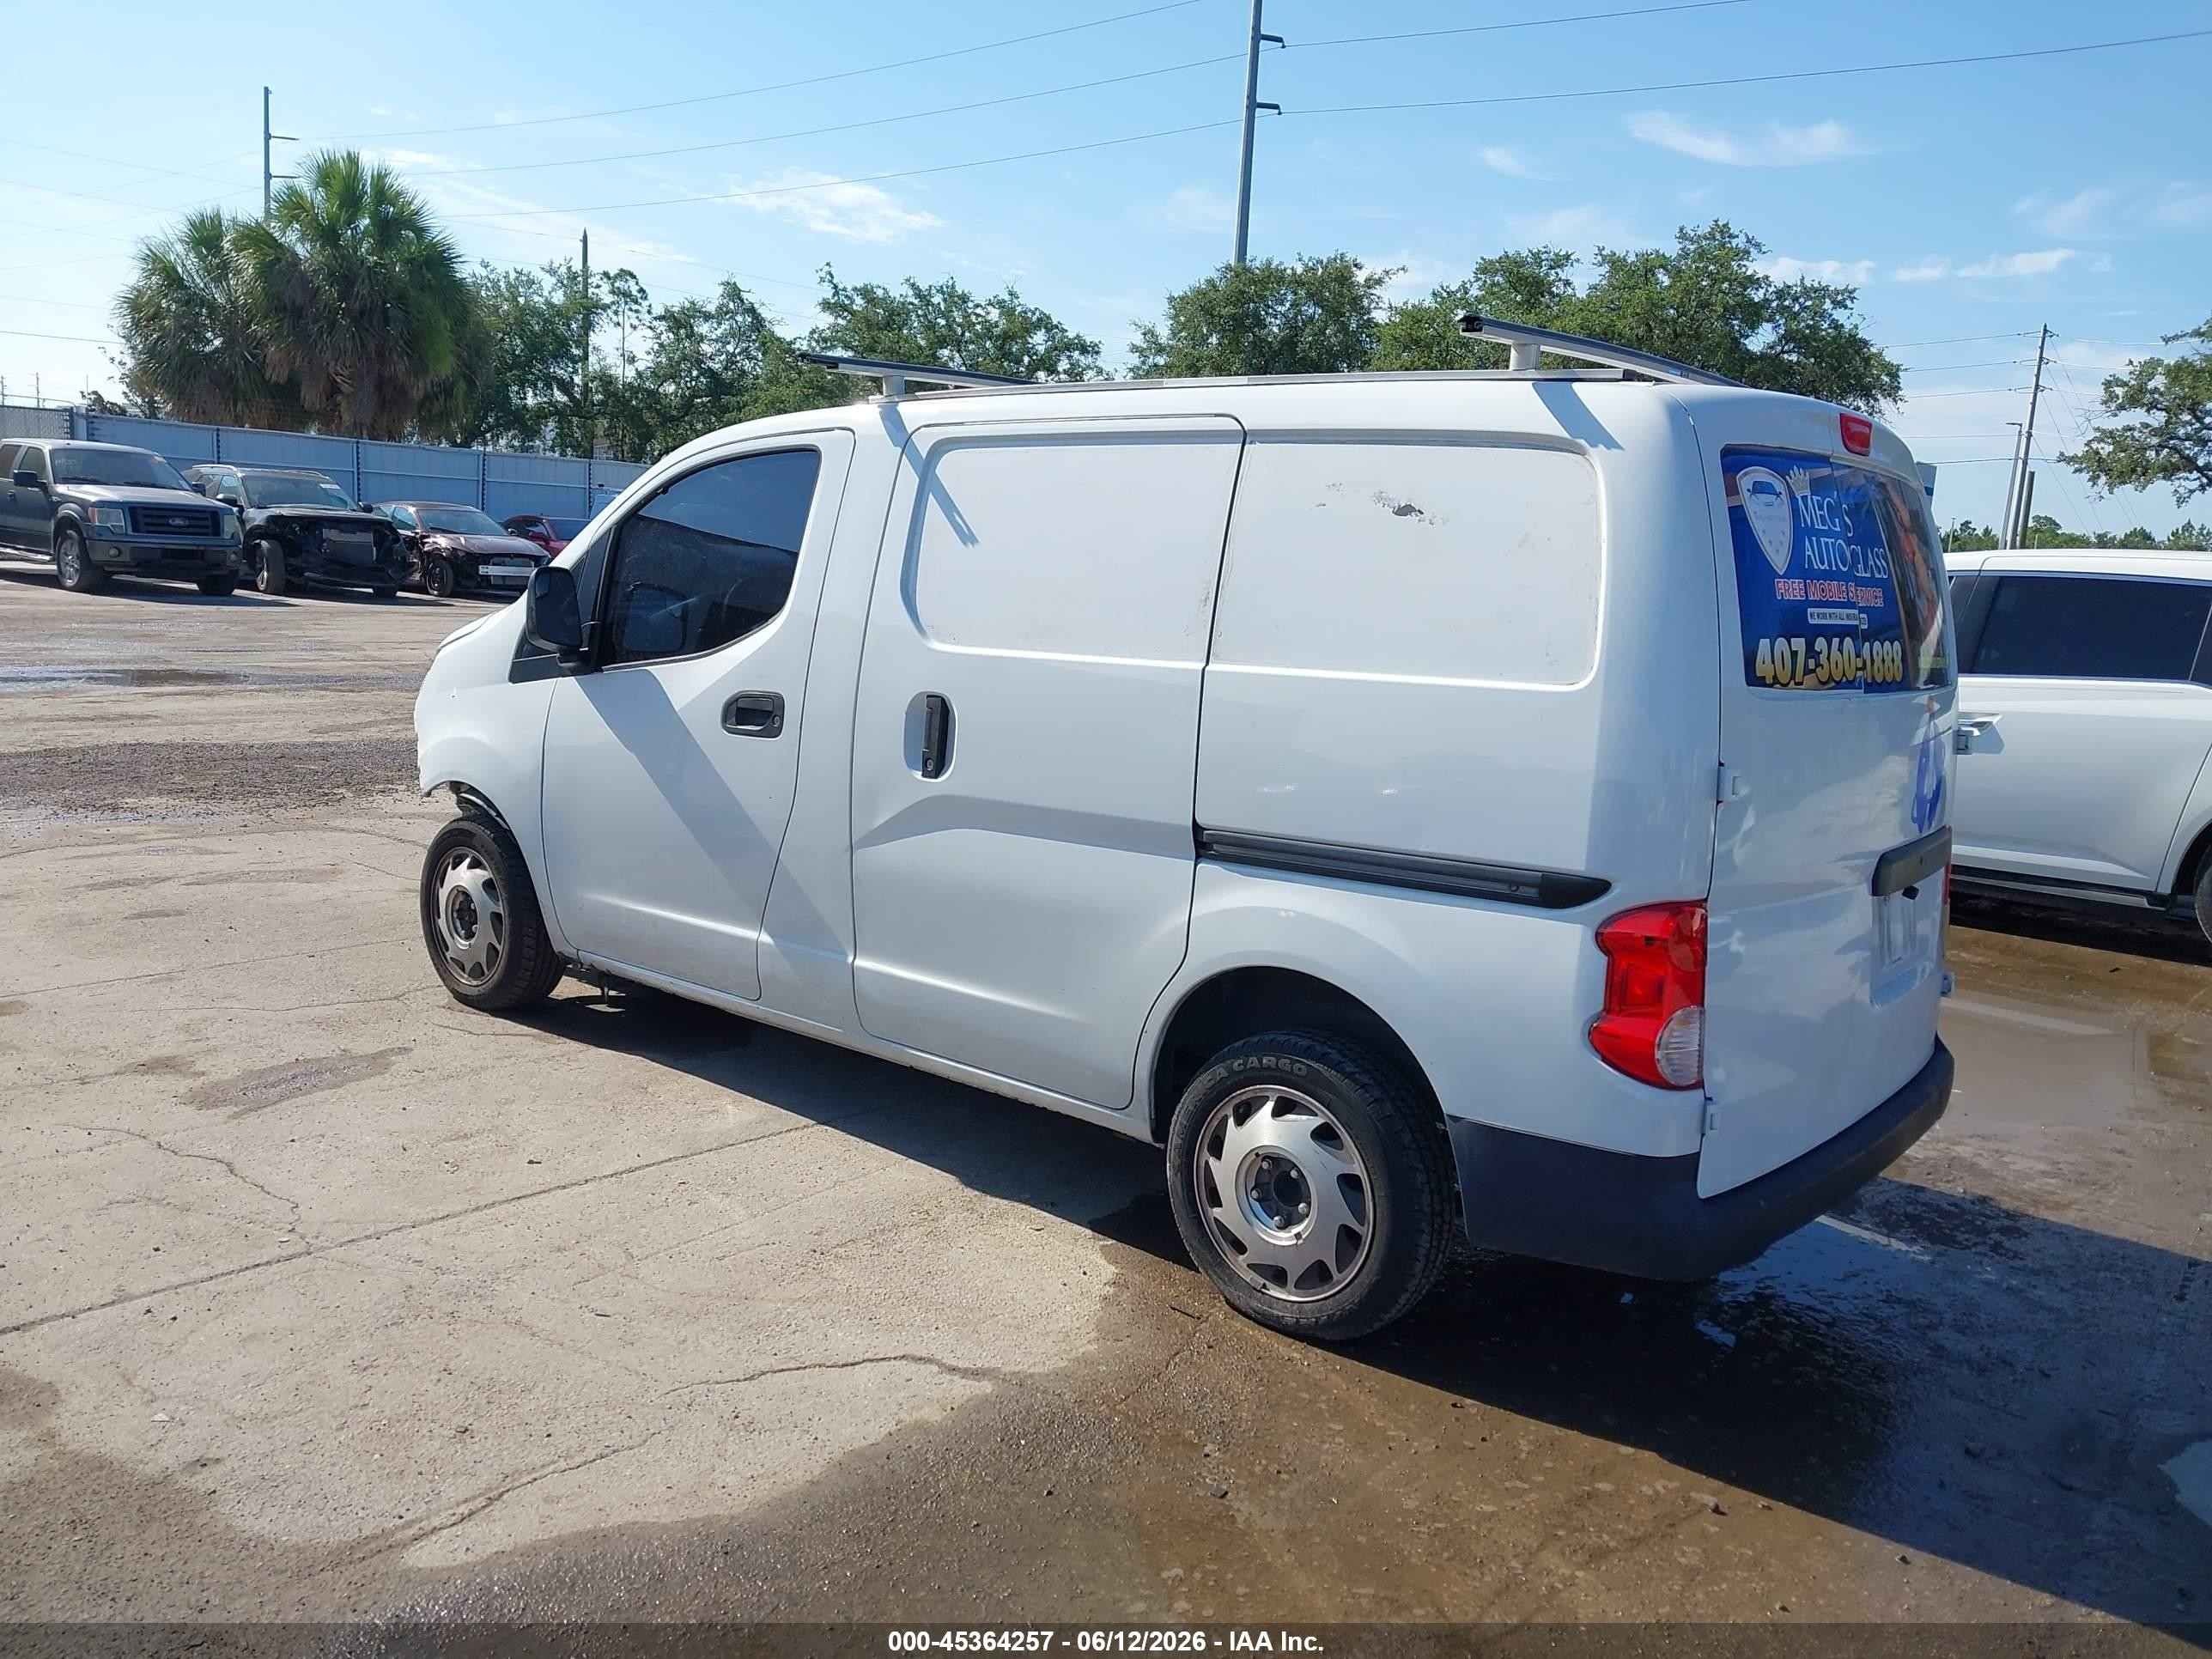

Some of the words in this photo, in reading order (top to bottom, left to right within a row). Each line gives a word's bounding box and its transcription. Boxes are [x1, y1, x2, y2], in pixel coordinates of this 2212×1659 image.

[1775, 579, 1806, 600] FREE
[1807, 580, 1848, 601] MOBILE
[1755, 636, 1904, 684] 407-360-1888
[1232, 1055, 1308, 1077] CARGO
